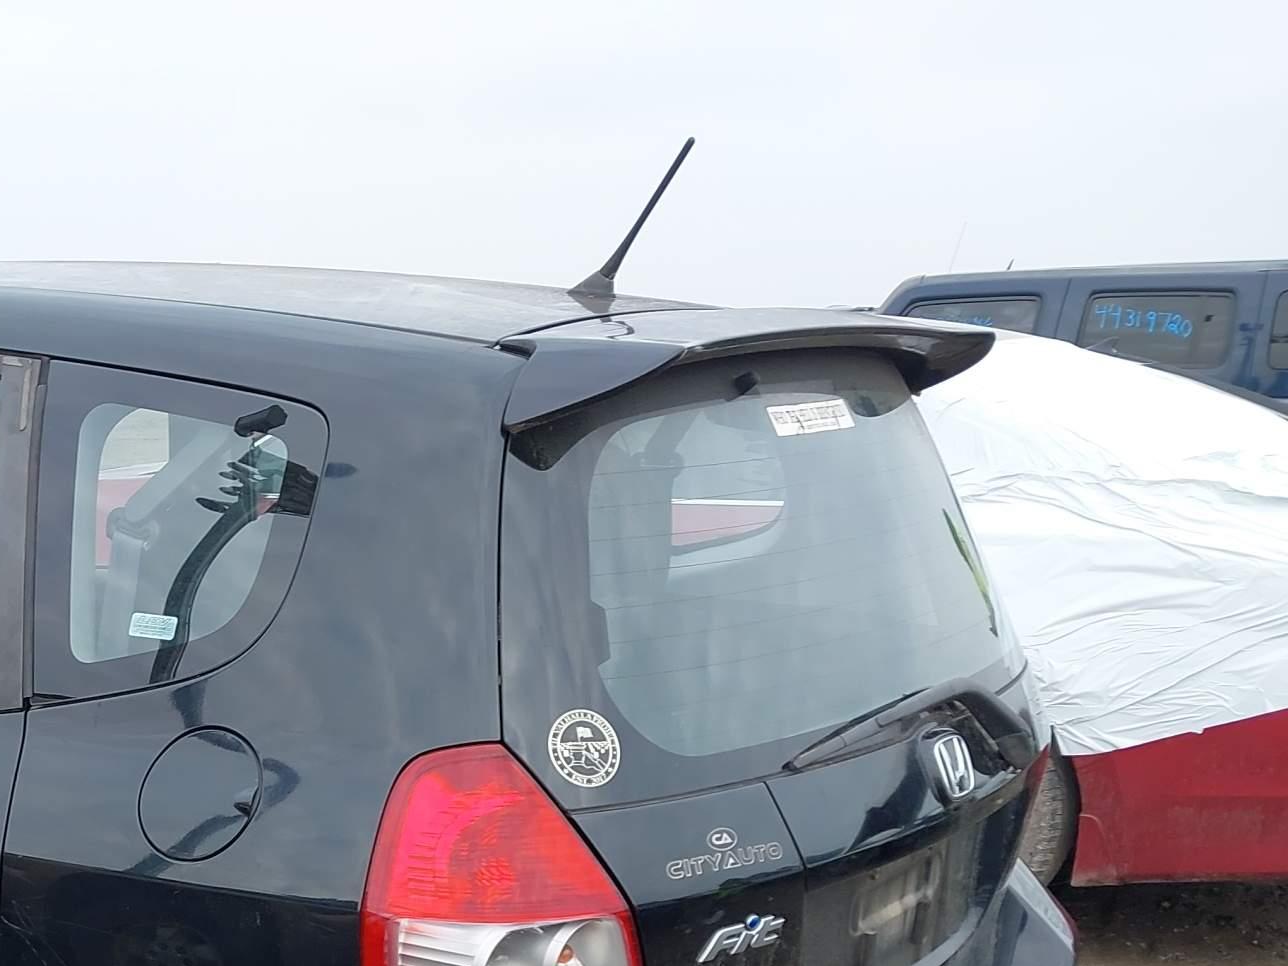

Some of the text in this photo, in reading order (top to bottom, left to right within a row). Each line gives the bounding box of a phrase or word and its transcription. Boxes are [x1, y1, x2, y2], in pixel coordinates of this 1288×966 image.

[1094, 303, 1193, 338] 44319720
[711, 833, 734, 845] CA
[696, 914, 787, 963] Fit
